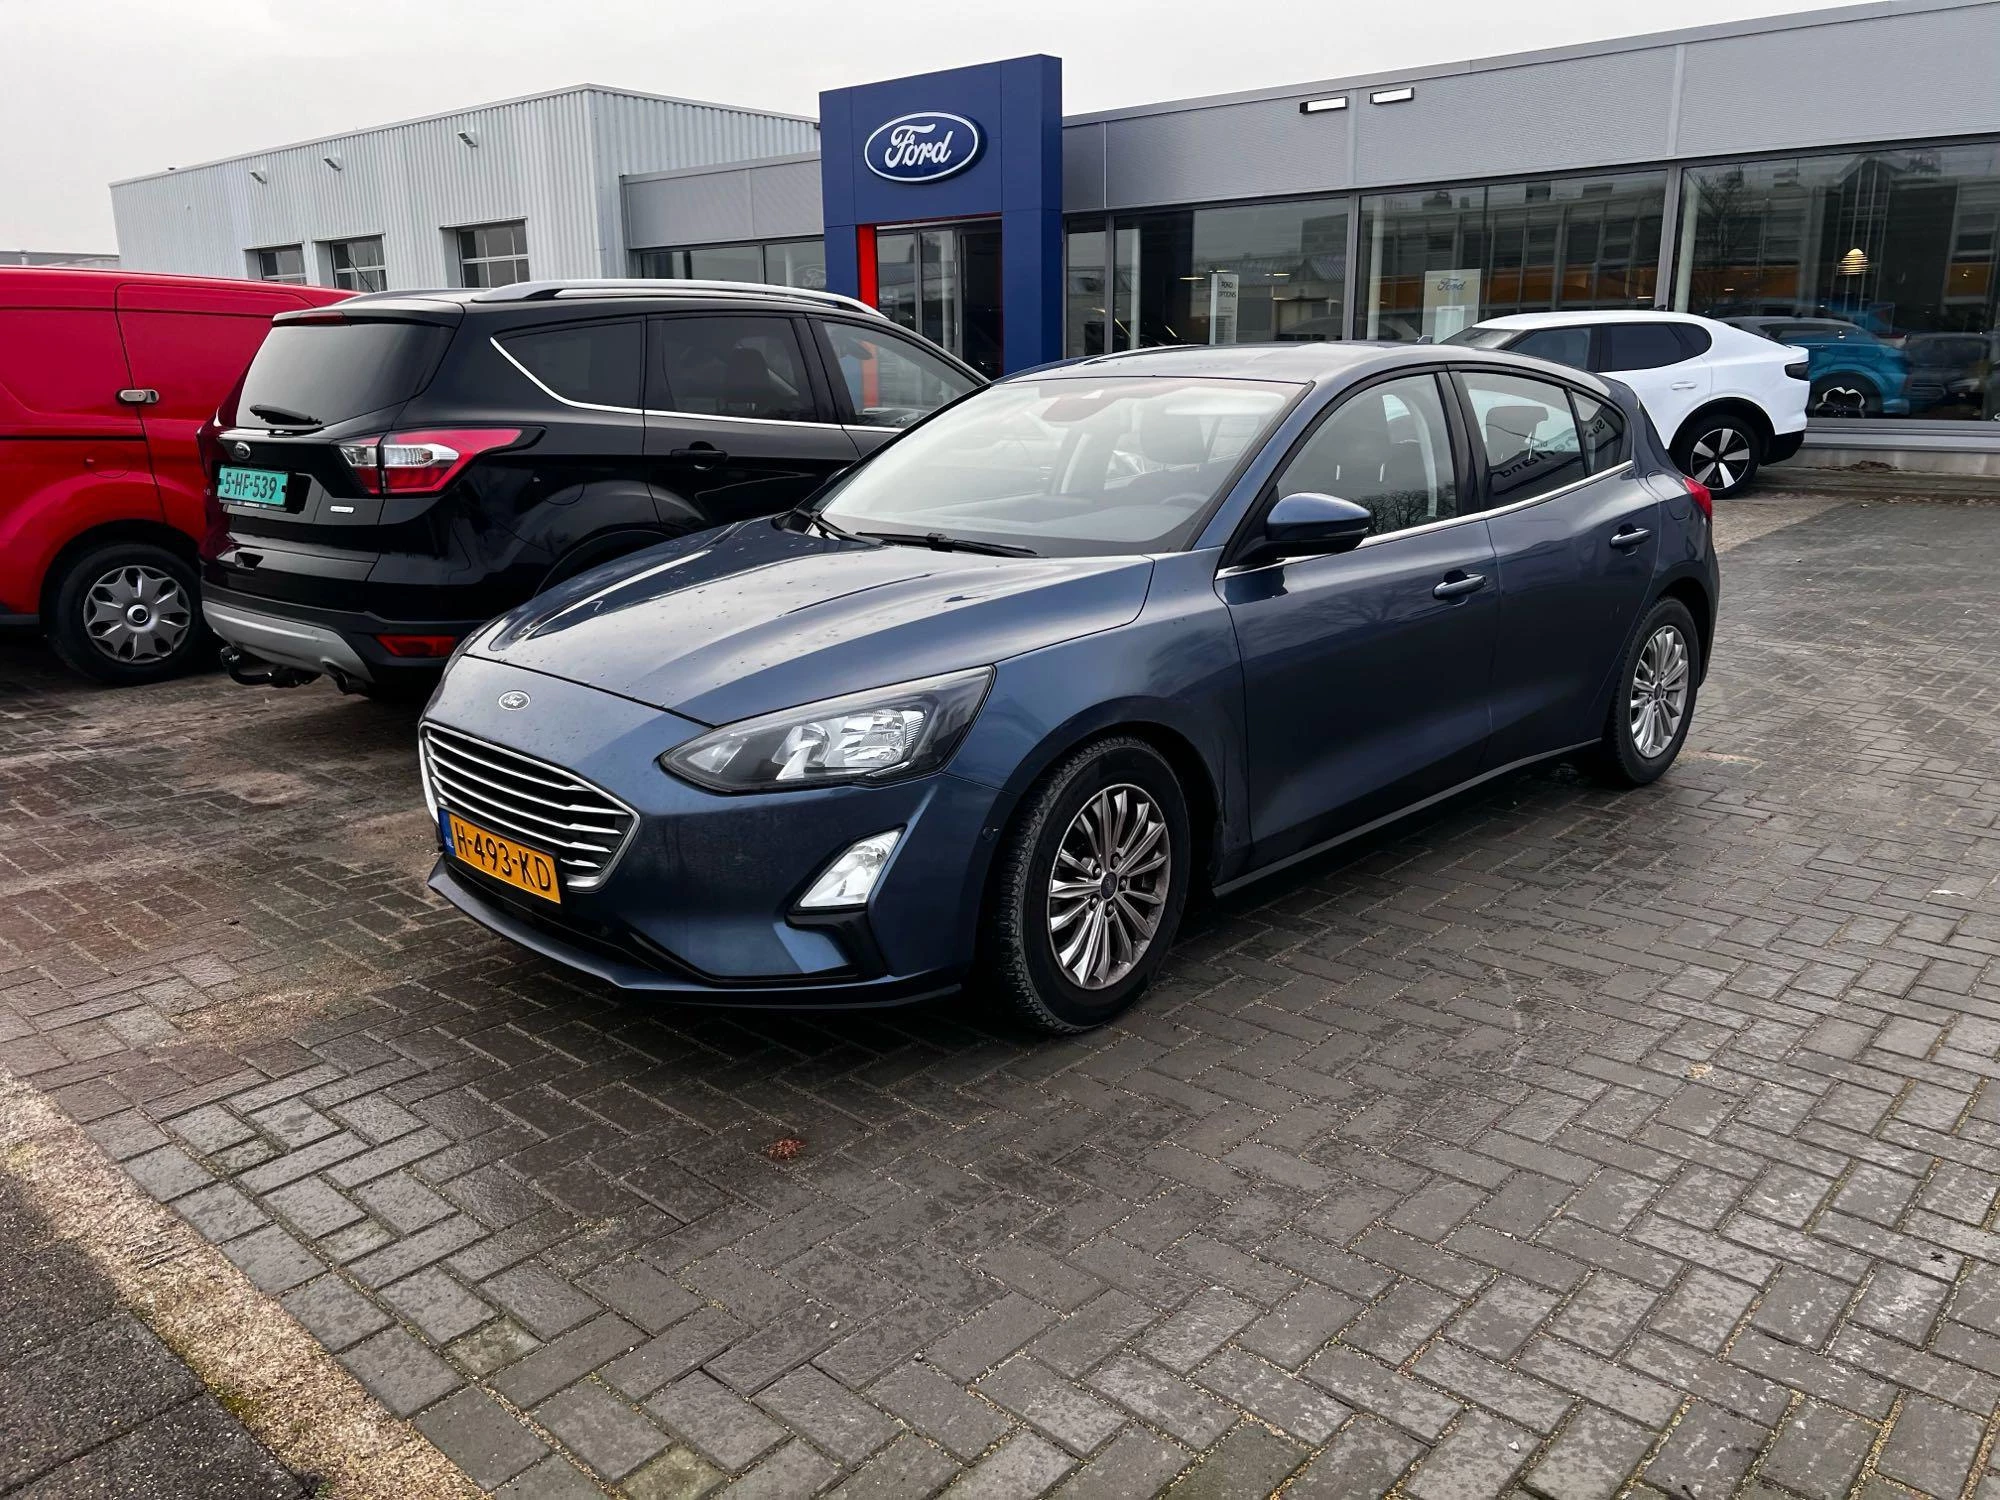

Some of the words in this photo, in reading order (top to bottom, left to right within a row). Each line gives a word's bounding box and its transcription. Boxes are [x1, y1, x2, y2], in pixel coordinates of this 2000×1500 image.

[885, 123, 954, 168] Ford
[1437, 278, 1466, 291] Ford
[454, 822, 551, 891] H-493-KD
